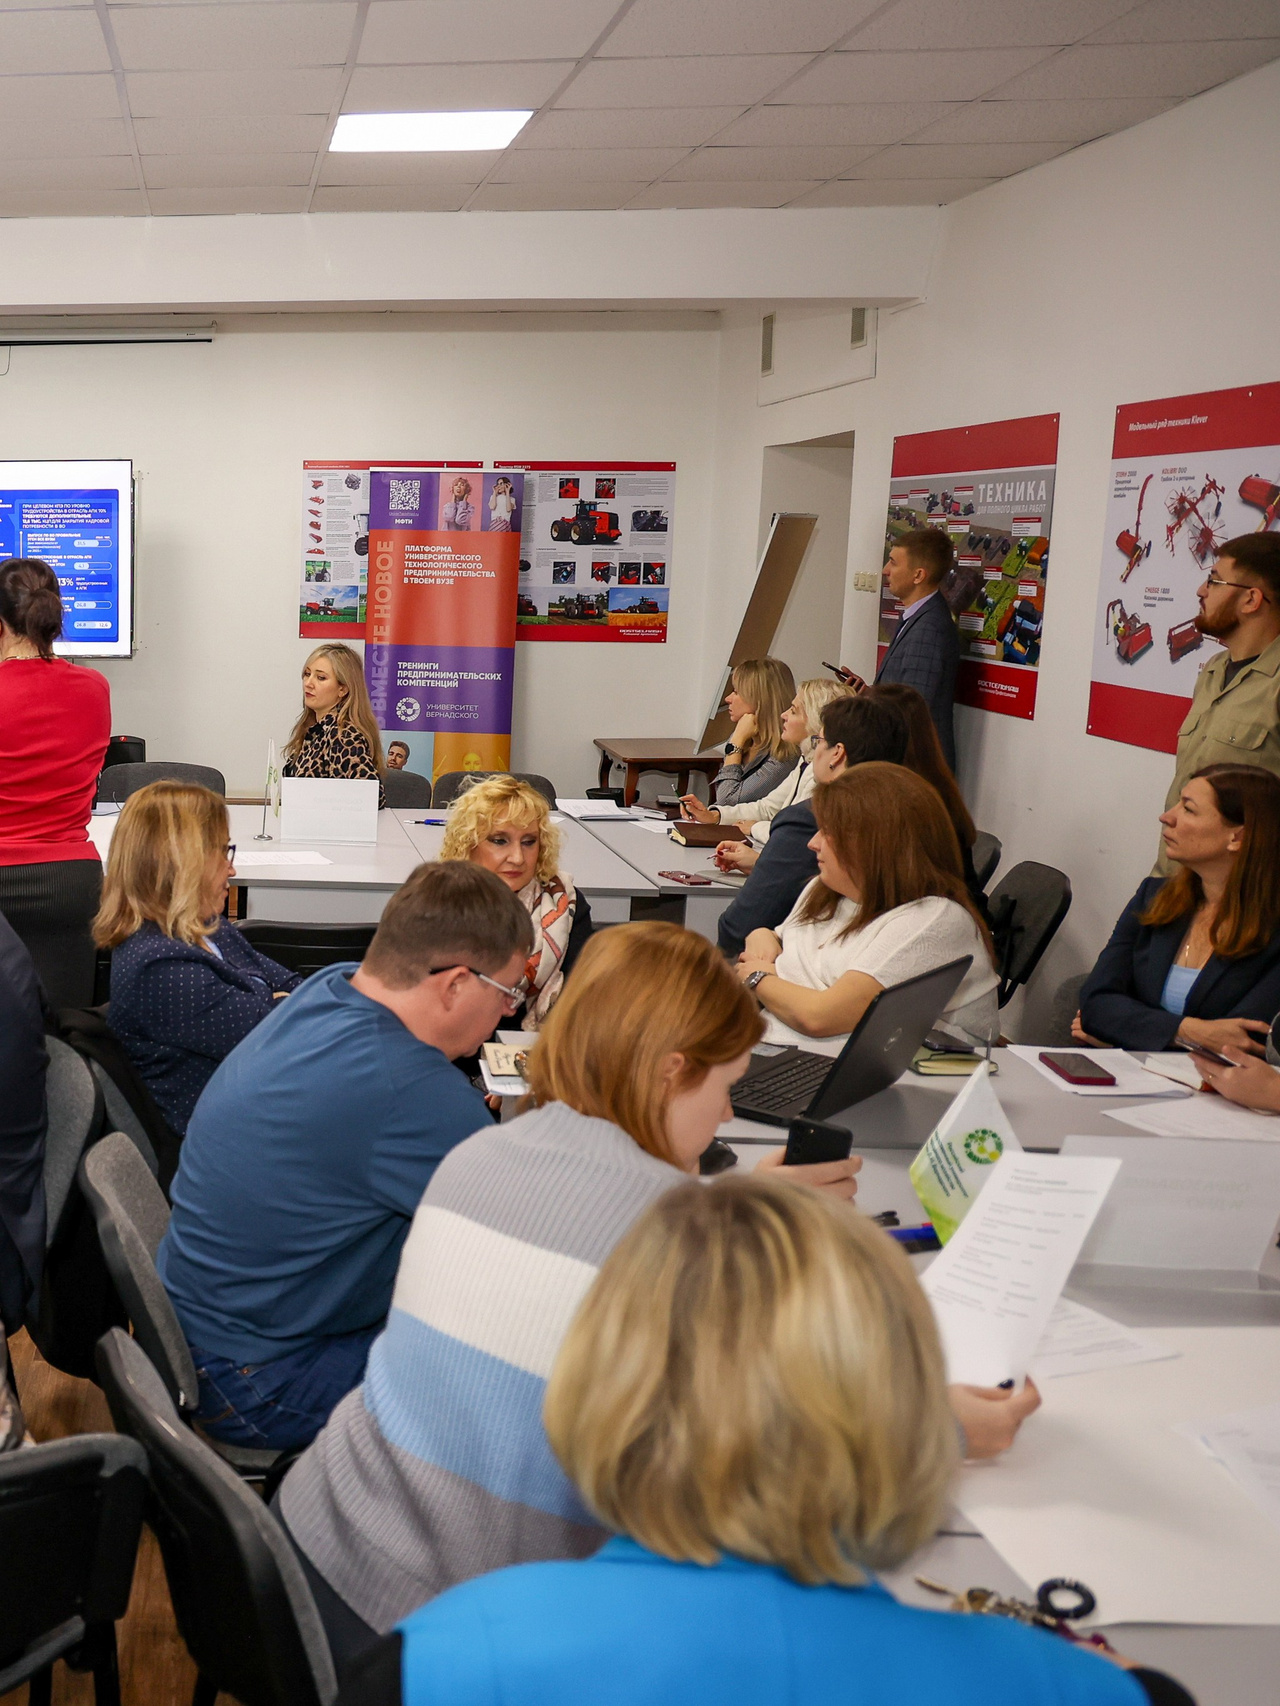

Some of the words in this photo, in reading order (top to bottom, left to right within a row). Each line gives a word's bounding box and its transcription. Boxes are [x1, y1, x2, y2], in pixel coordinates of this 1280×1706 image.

[1128, 420, 1157, 431] Модельный
[1157, 419, 1167, 430] ряд
[1168, 418, 1191, 427] техники
[1191, 415, 1208, 424] Klever
[978, 480, 1046, 502] ТЕХНИКА
[977, 506, 988, 514] ДЛЯ
[988, 505, 1011, 514] ПОЛНОГО
[1011, 504, 1028, 514] ЦИКЛА
[1028, 504, 1046, 512] РАБОТ
[405, 553, 481, 561] УНИВЕРСИТЕТСКОГО
[404, 570, 495, 578] ПРЕДПРИНИМАТЕЛЬСТВА
[374, 541, 394, 618] НОВОЕ
[370, 625, 390, 711] ВМЕСТЕ
[398, 662, 439, 670] ТРЕНИНГИ
[398, 670, 501, 680] ПРЕДПРИНИМАТЕЛЬСКИХ
[397, 678, 458, 688] КОМПЕТЕНЦИЙ
[978, 680, 1019, 693] РОСТСЕЛЬМАШ
